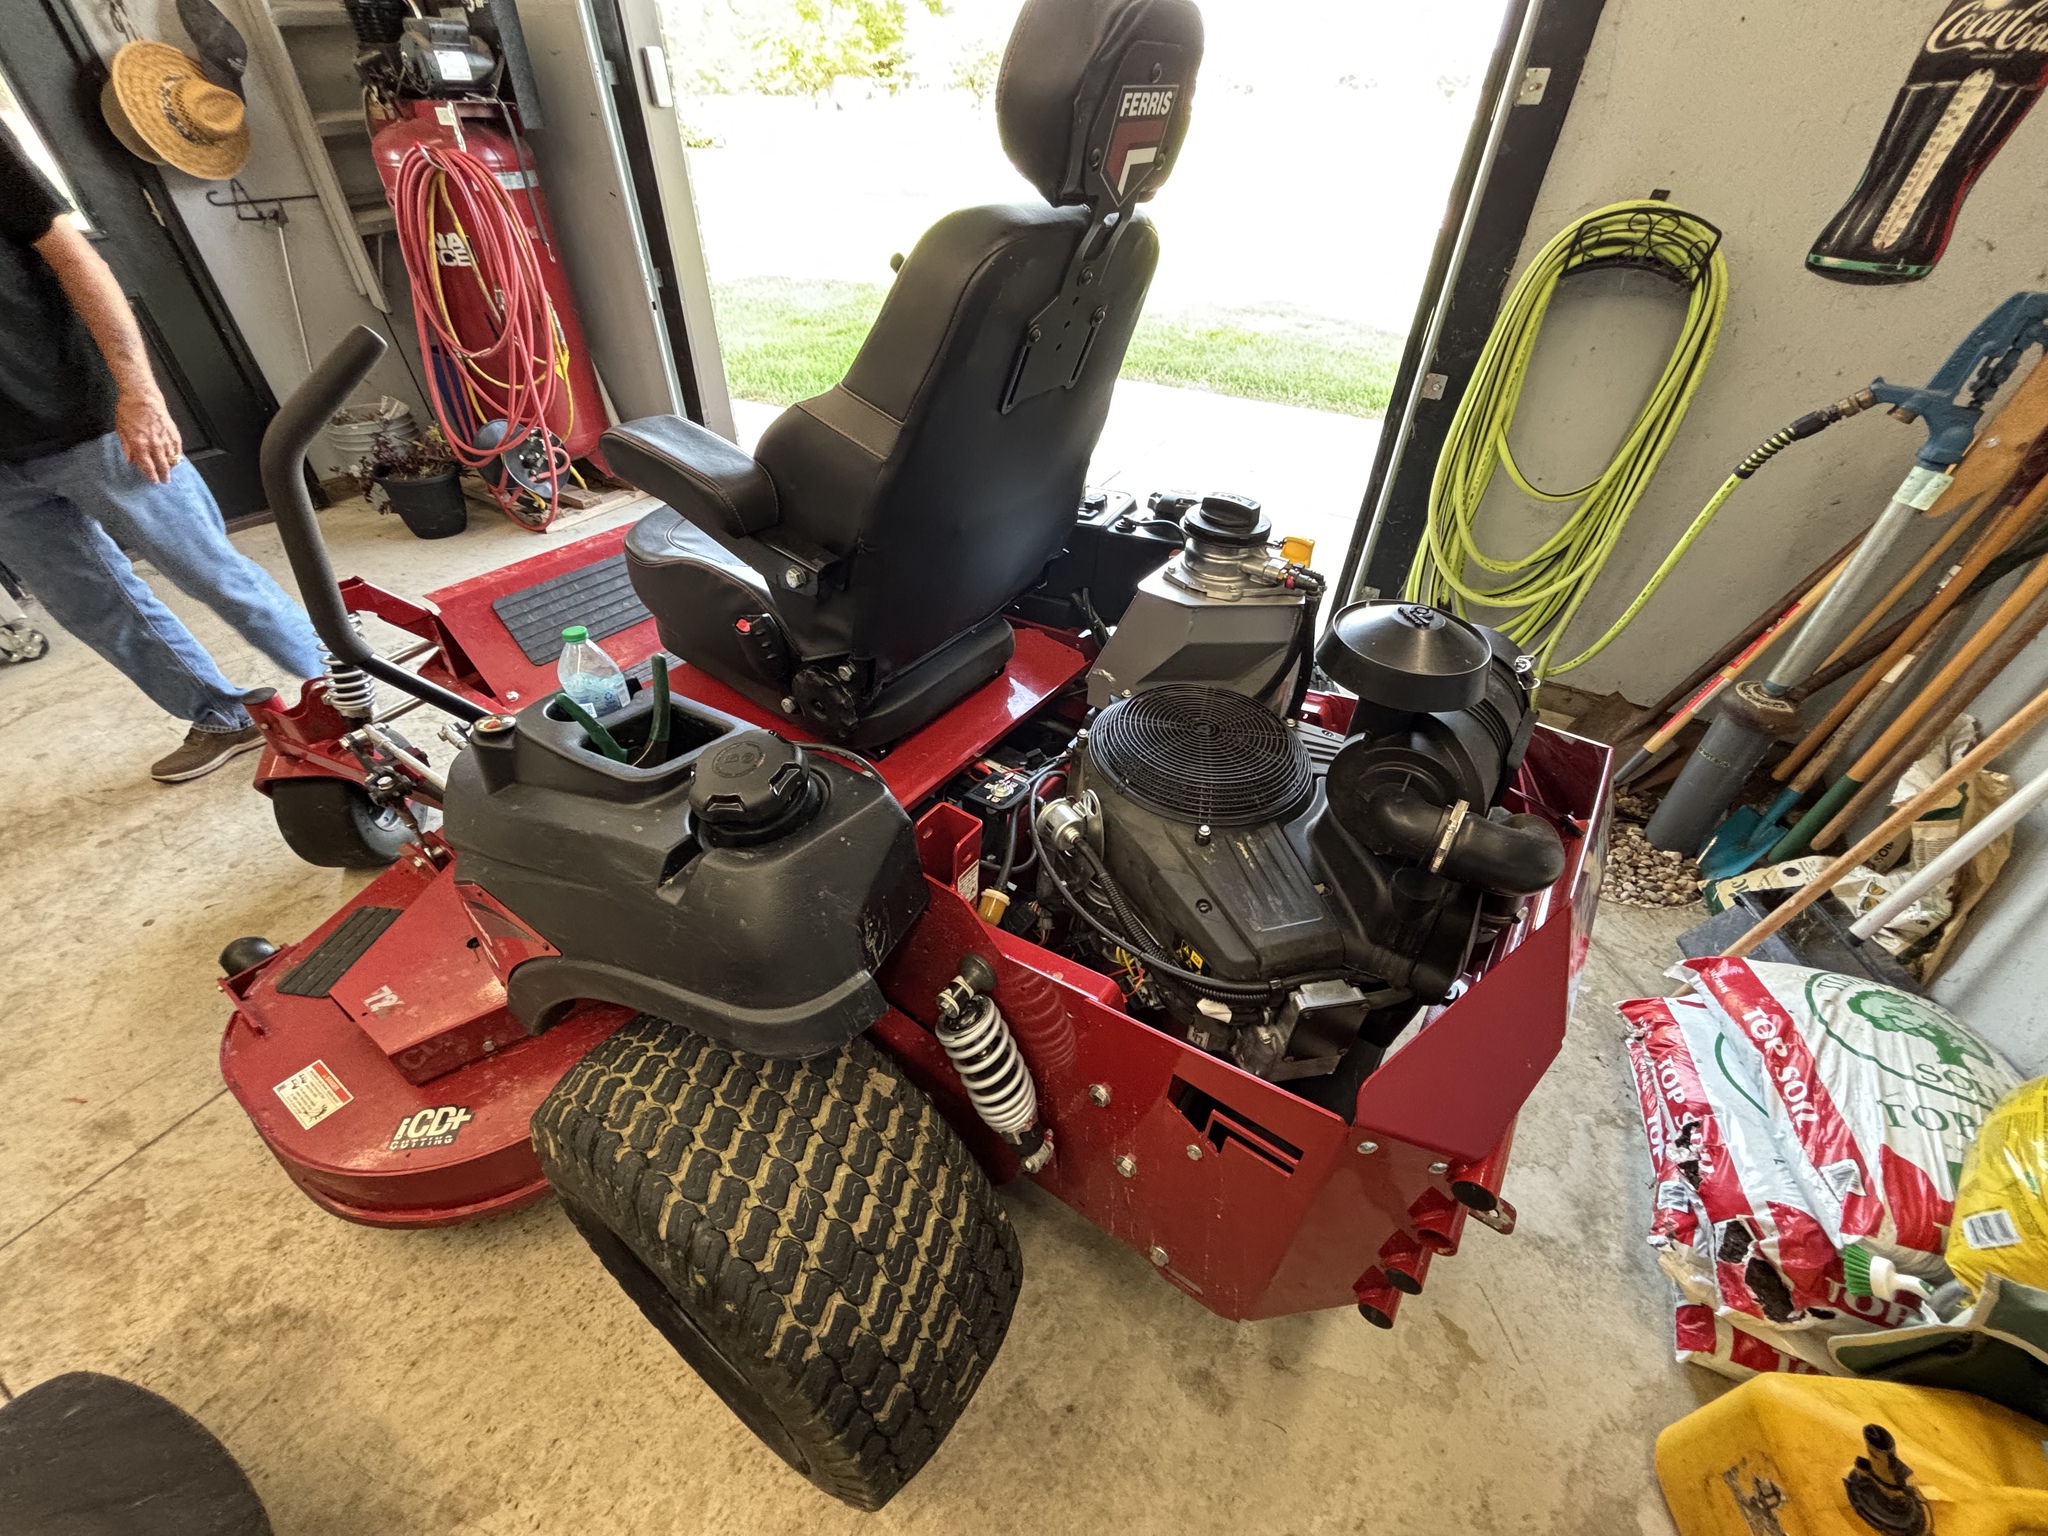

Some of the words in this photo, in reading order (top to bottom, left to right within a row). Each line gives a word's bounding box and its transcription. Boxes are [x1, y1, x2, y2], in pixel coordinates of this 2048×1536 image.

[1119, 91, 1173, 117] FERRIS
[1657, 1055, 1686, 1105] TOP
[1742, 1006, 1788, 1057] TOP
[1774, 1066, 1819, 1129] SOIL
[1877, 1099, 1978, 1141] TOP
[389, 1135, 453, 1150] CUTTING
